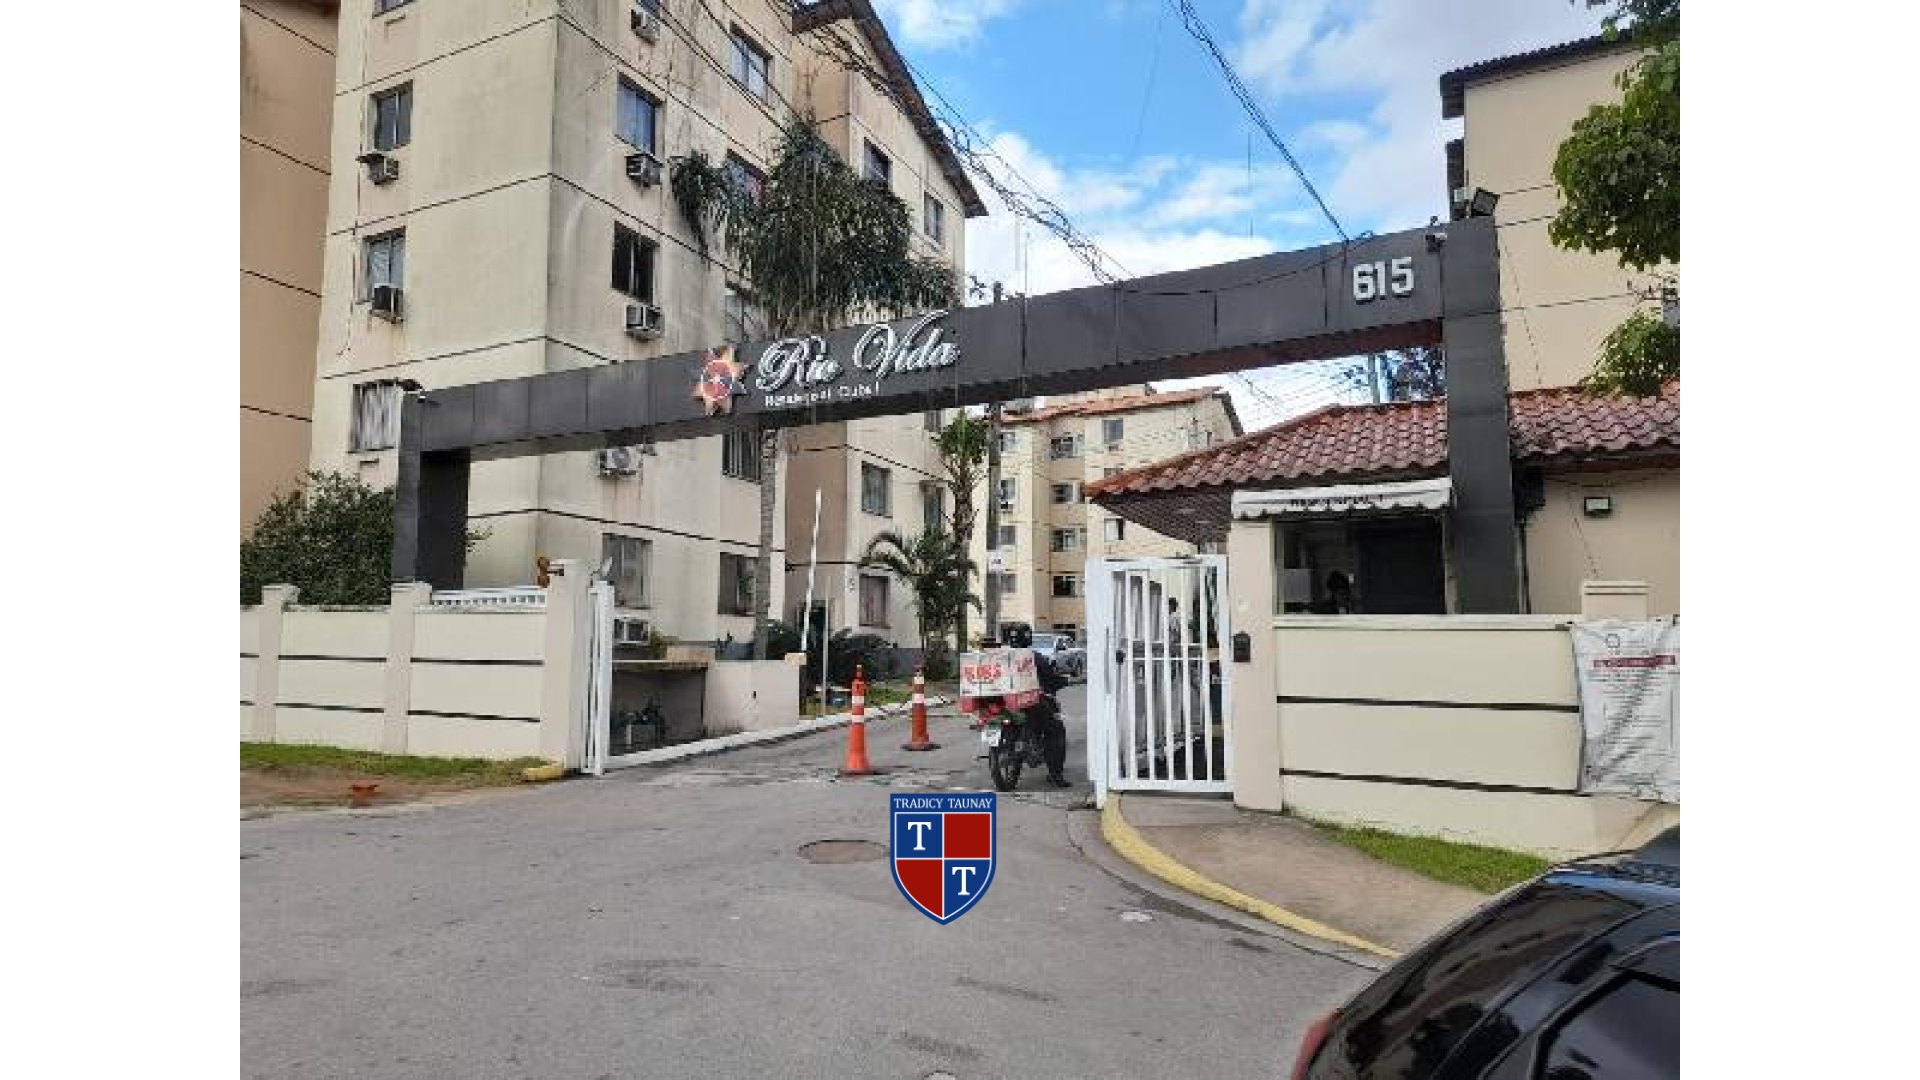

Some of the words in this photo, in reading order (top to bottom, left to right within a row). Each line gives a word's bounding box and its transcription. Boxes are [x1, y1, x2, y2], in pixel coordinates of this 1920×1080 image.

[1353, 256, 1414, 300] 615
[756, 335, 842, 390] Rio
[852, 309, 960, 379] Vida
